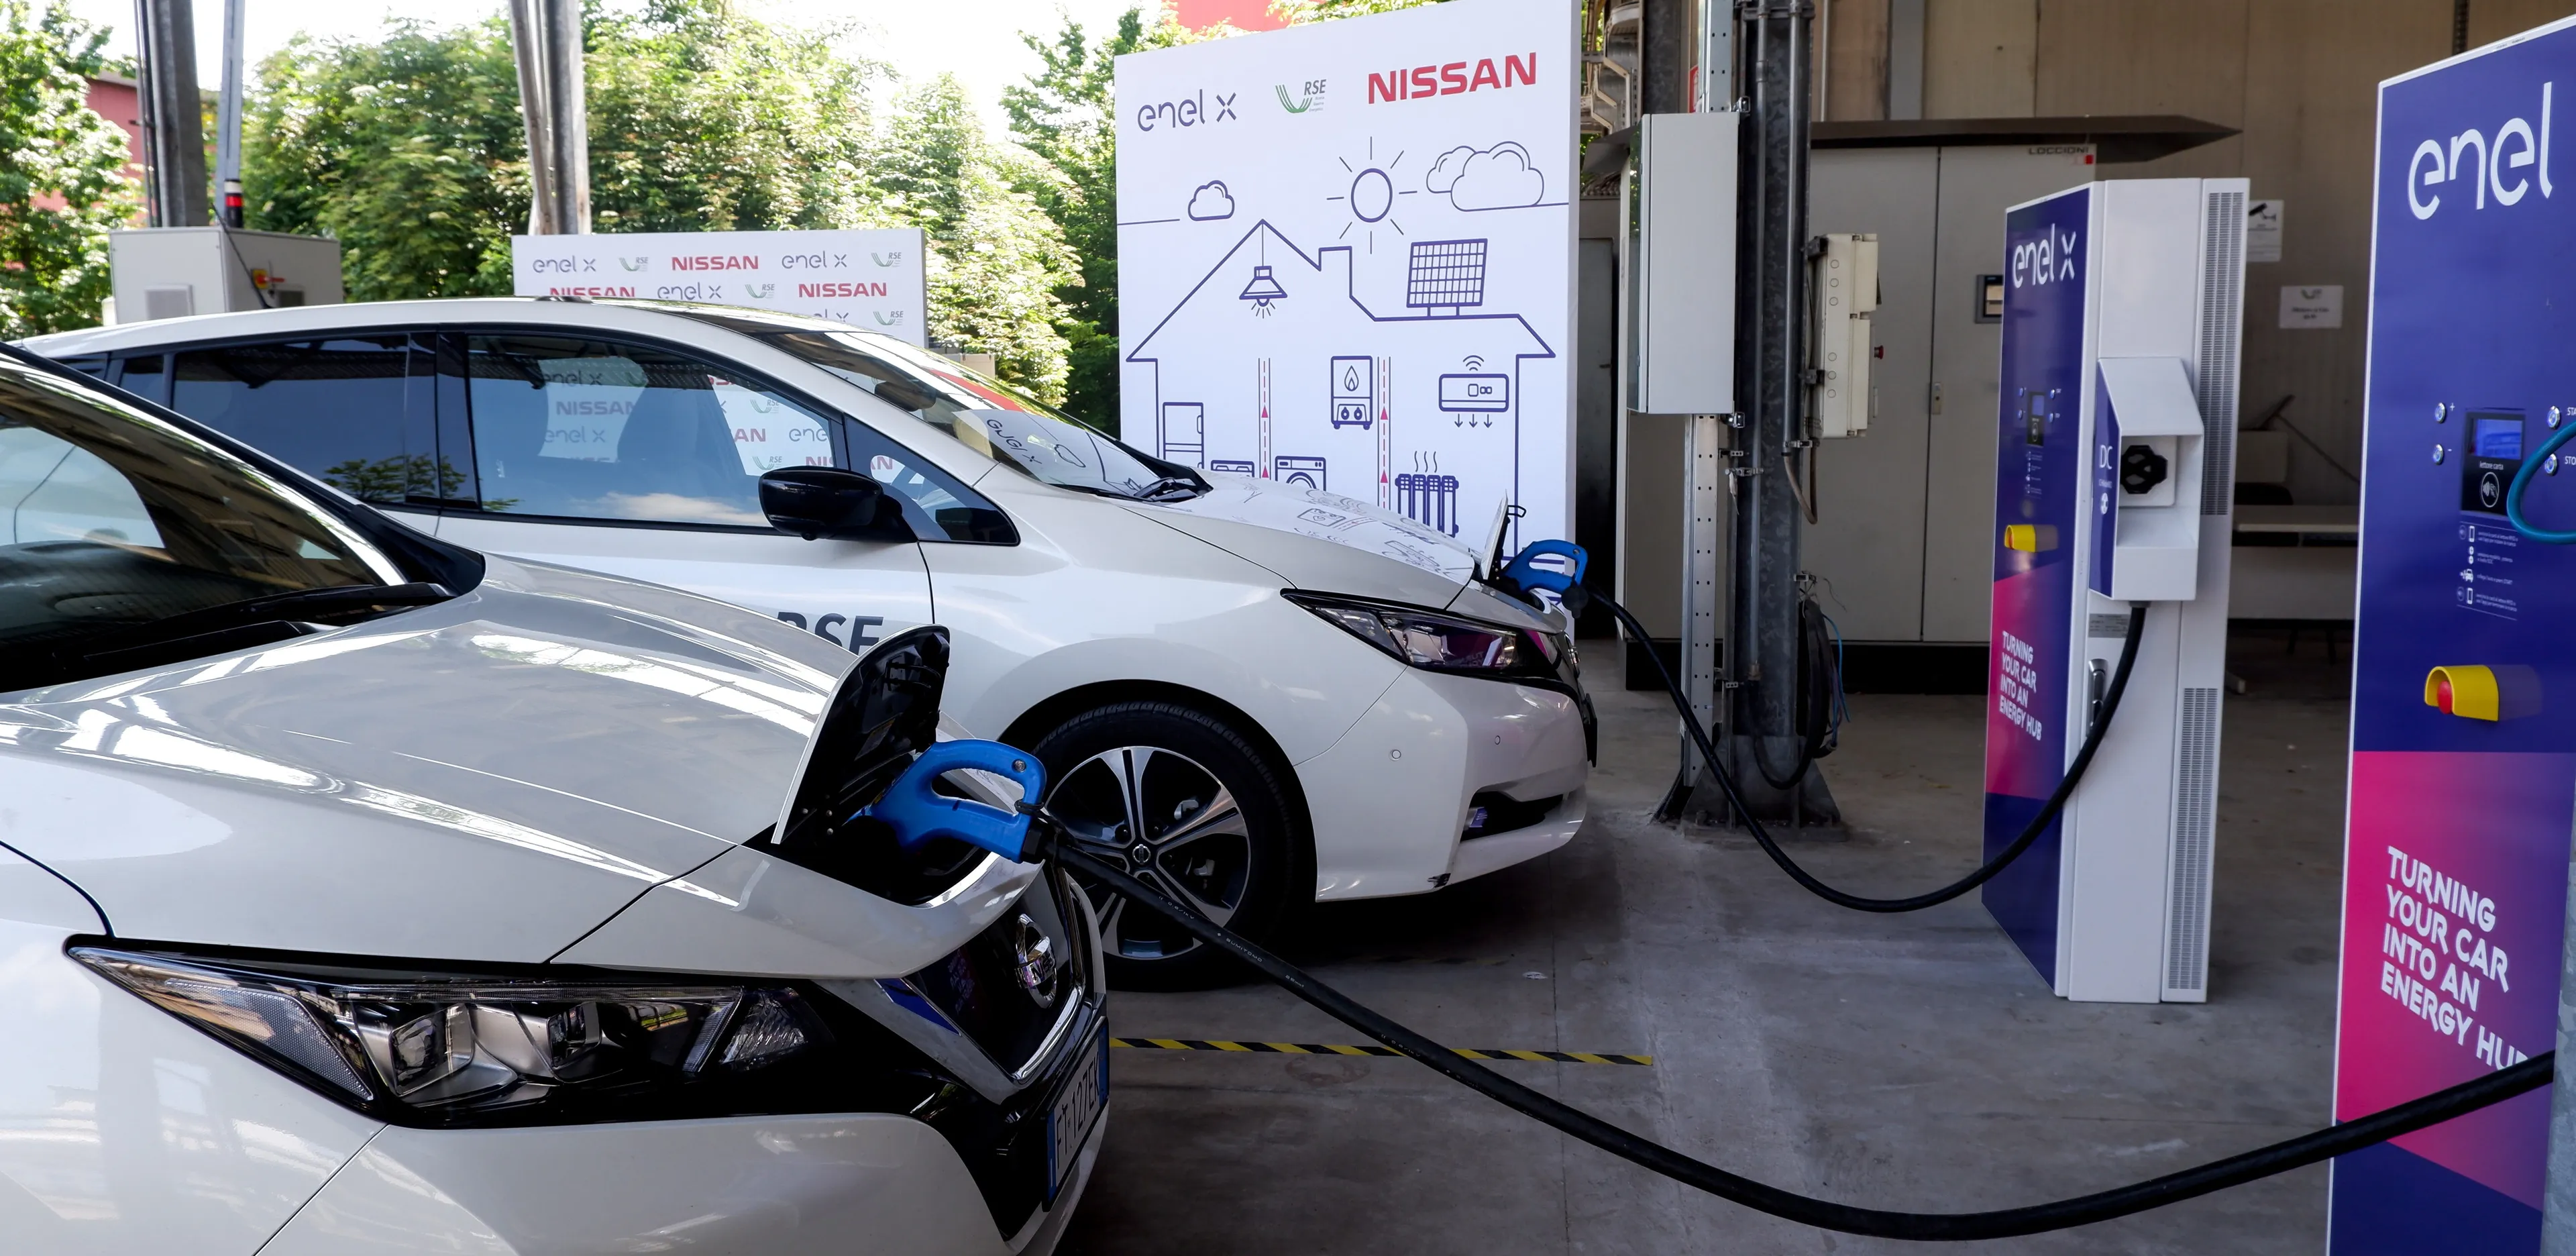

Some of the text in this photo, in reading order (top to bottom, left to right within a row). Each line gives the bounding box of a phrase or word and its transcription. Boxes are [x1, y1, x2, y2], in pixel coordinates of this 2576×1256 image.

[1303, 78, 1327, 96] RSE
[1368, 52, 1537, 105] NISSAN
[1137, 89, 1237, 132] enel x
[2028, 146, 2090, 155] LOCCIONI
[2408, 81, 2553, 220] enel
[532, 255, 596, 274] enel x
[635, 256, 649, 264] RSE
[672, 255, 759, 271] NISSAN
[781, 250, 847, 269] enel x
[888, 252, 902, 260] RSE
[2012, 222, 2077, 289] enel x
[549, 286, 635, 297] NISSAN
[657, 281, 722, 301] enel x
[761, 283, 775, 291] RSE
[798, 282, 887, 298] NISSAN
[890, 310, 904, 318] RSE
[788, 427, 827, 442] ene
[769, 456, 782, 464] RSE
[2099, 444, 2113, 470] DC
[2002, 630, 2034, 664] TURNING
[2001, 651, 2037, 693] YOUR CAR
[2000, 674, 2029, 708] INTO AN
[1999, 695, 2043, 741] ENERGY HUB
[2387, 845, 2496, 933] TURNING
[2385, 883, 2510, 993] YOUR CAR
[1226, 937, 1263, 963] SUMITOMO
[2382, 923, 2481, 1012] INTO AN
[2380, 960, 2474, 1047] ENERGY
